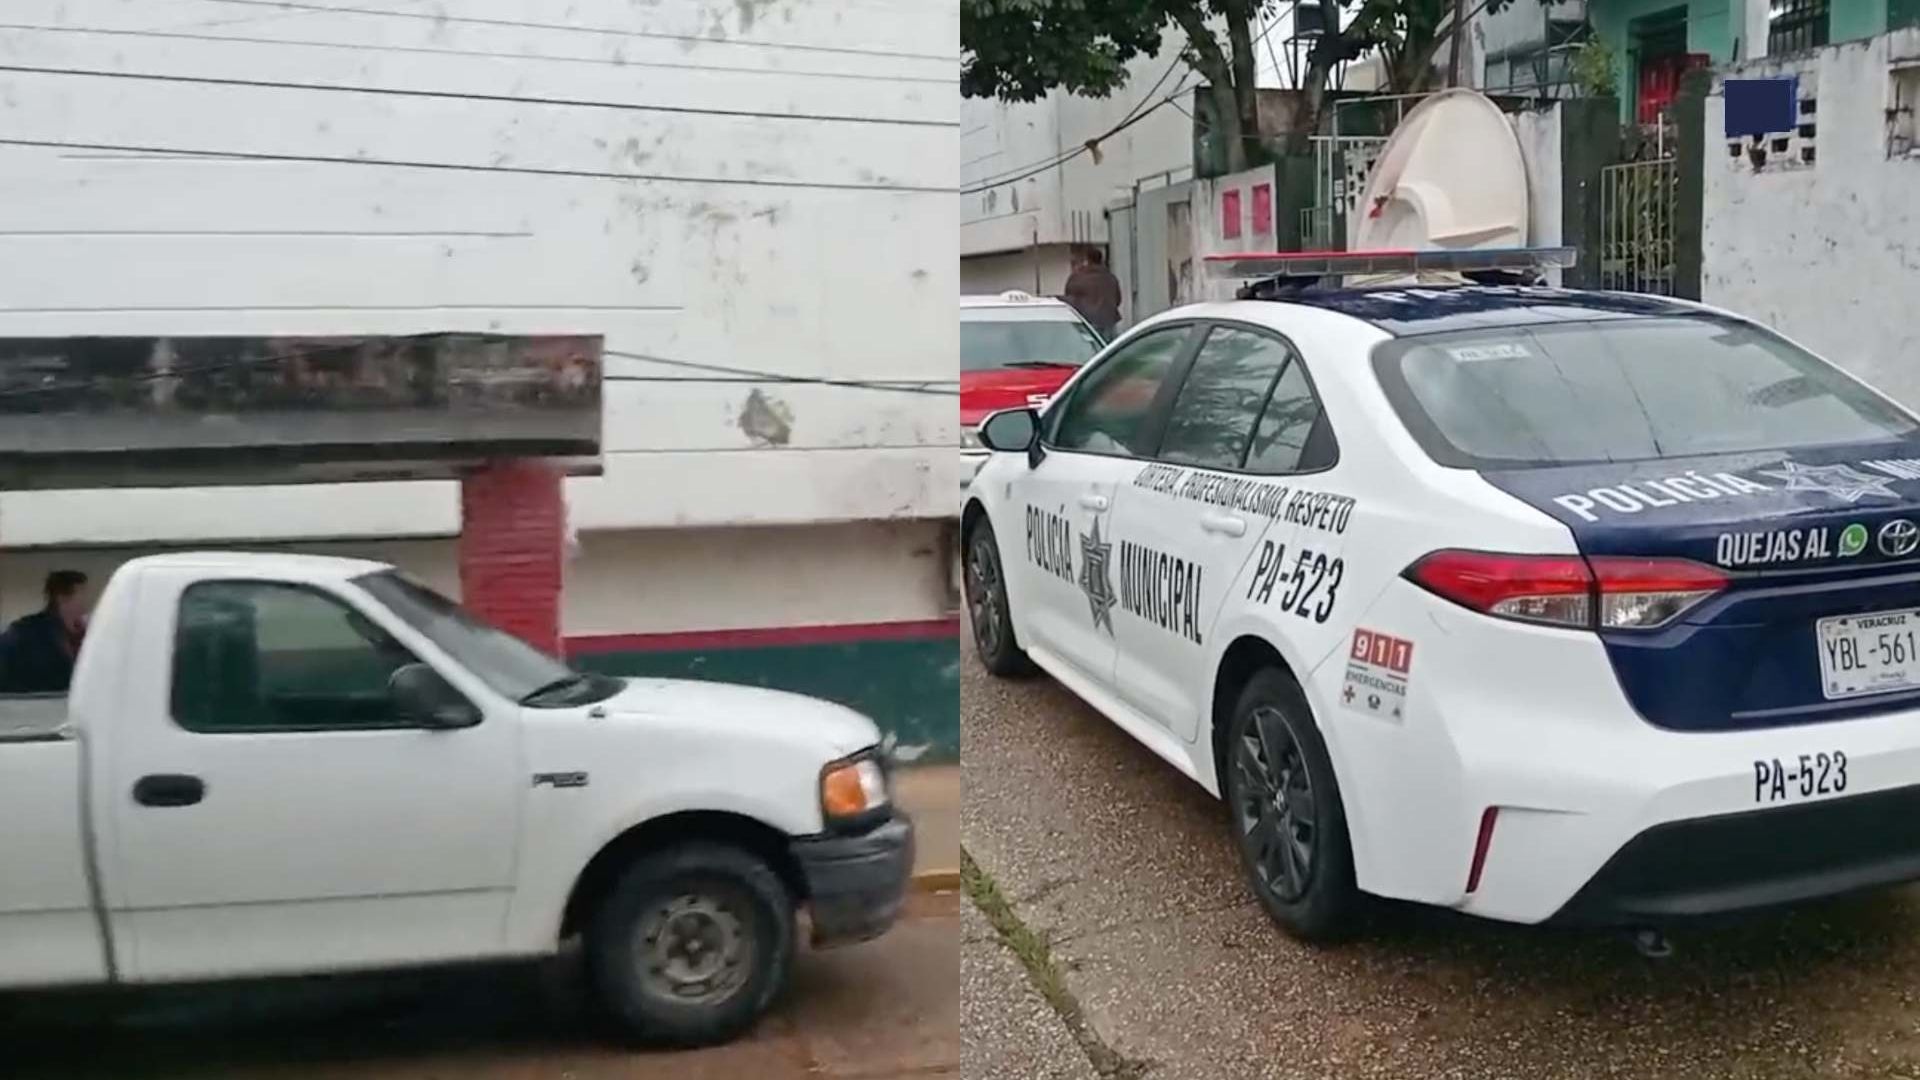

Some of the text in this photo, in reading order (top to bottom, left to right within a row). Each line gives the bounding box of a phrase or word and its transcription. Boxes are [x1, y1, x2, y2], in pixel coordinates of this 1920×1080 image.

[1284, 489, 1357, 535] RESPETO
[1553, 470, 1774, 522] POLICÍA
[1716, 527, 1832, 566] QUEJAS AL
[1026, 503, 1203, 646] POLICÍA MUNICIPAL
[1246, 540, 1344, 624] PA-523
[1856, 615, 1907, 630] VERACRUZ
[1354, 634, 1407, 669] 911
[1825, 630, 1918, 673] YBL-561
[1344, 669, 1407, 697] EMERGENCIAS
[1753, 750, 1848, 802] PA-523
